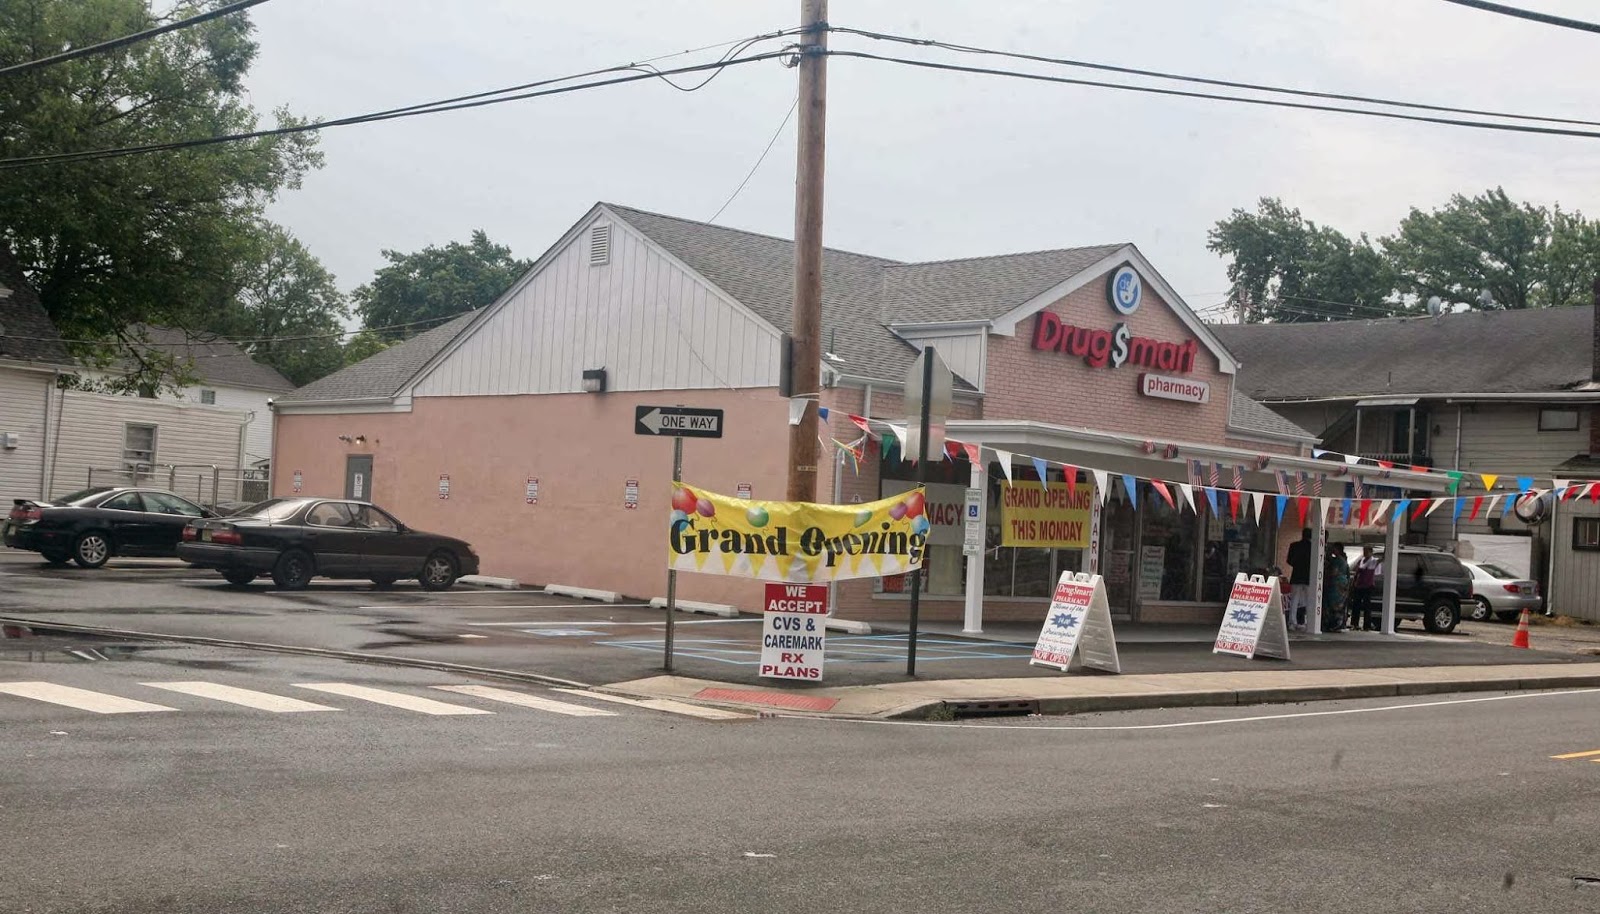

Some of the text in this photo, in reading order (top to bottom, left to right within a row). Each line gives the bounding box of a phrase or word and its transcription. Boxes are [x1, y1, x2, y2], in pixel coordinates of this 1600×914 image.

[1148, 378, 1205, 400] pharmacy
[661, 416, 714, 429] ONE WAY
[1004, 487, 1041, 508] GRAND
[1044, 487, 1091, 510] OPENING
[1011, 520, 1083, 542] THIS MONDAY
[670, 518, 789, 556] Grand
[800, 522, 928, 566] Opening
[786, 586, 806, 598] WE
[1058, 584, 1093, 597] DrugSmart
[1234, 584, 1271, 596] DrugSmart
[1055, 595, 1088, 605] PHARMACY
[1232, 593, 1267, 603] PHARMACY
[768, 600, 823, 613] ACCEPT
[773, 617, 816, 632] CVS &
[764, 634, 823, 650] CAREMARK
[1216, 641, 1253, 653] NOW OPEN
[781, 652, 804, 664] RX
[1033, 651, 1068, 664] NOW OPEN
[762, 665, 820, 678] PLANS
